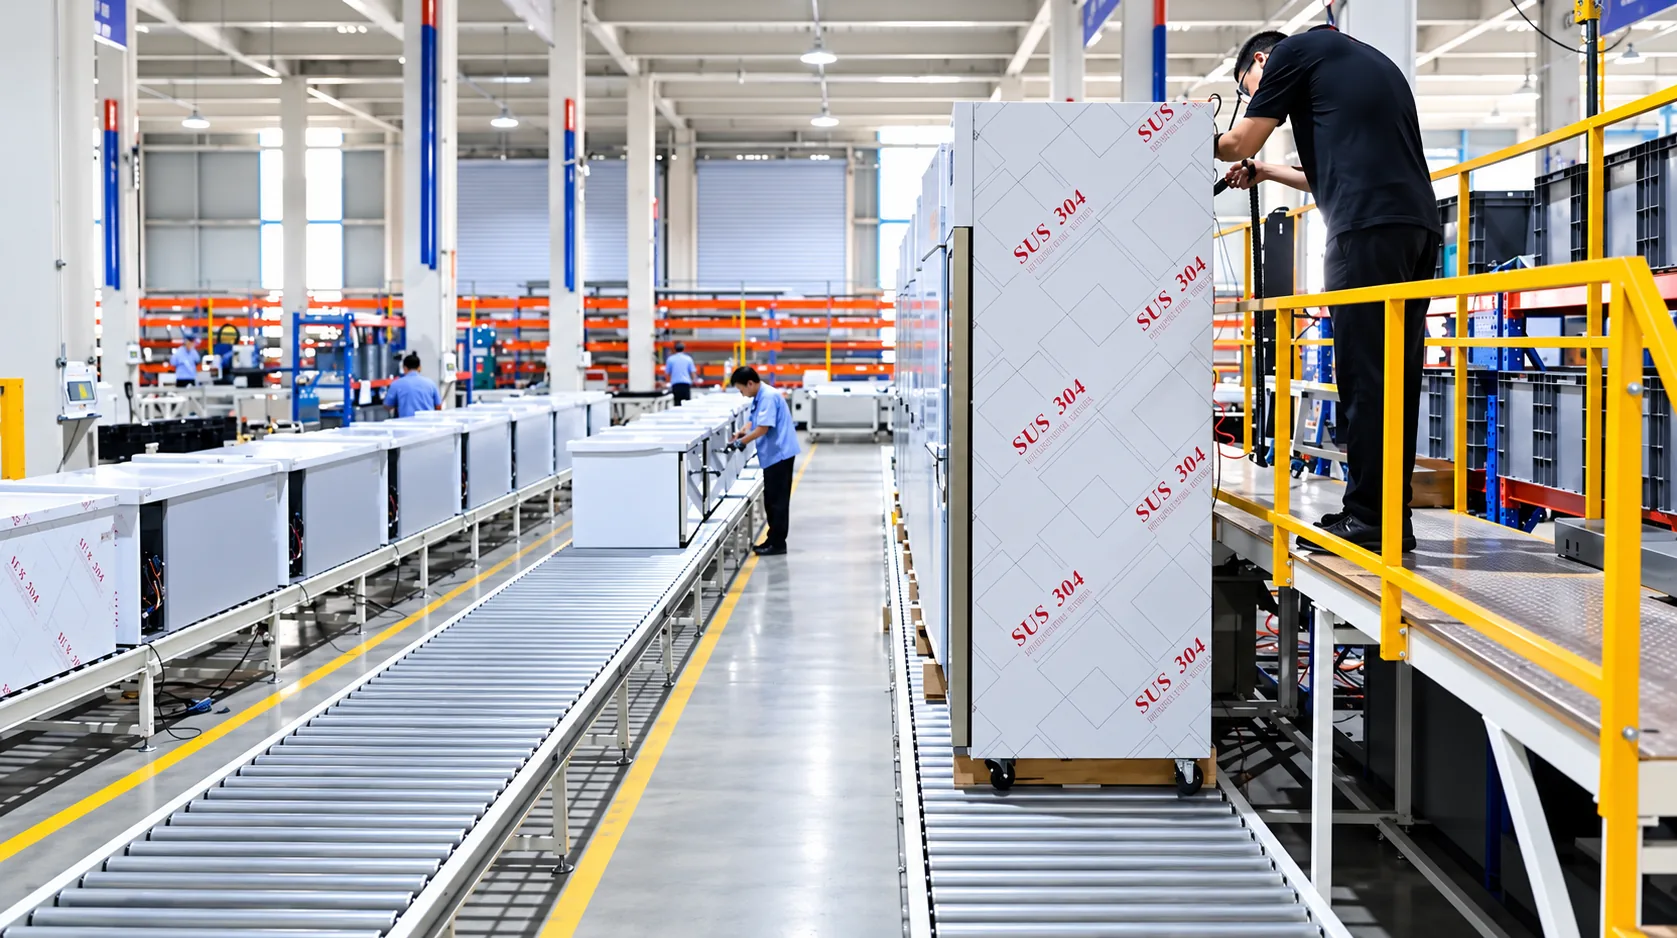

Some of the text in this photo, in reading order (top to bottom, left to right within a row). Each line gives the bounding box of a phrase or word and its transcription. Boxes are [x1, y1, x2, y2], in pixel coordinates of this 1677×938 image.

[1138, 103, 1174, 143] SUS
[1013, 223, 1051, 265] SUS
[1053, 188, 1086, 225] 304
[1136, 290, 1173, 331] SUS
[1175, 256, 1207, 292] 304
[1012, 413, 1050, 455] SUS
[1053, 378, 1086, 415] 304
[1135, 481, 1172, 523] SUS
[1174, 446, 1206, 483] 304
[1011, 604, 1049, 647] SUS
[1052, 570, 1085, 607] 304
[1135, 672, 1171, 714] SUS
[1174, 637, 1206, 674] 304
